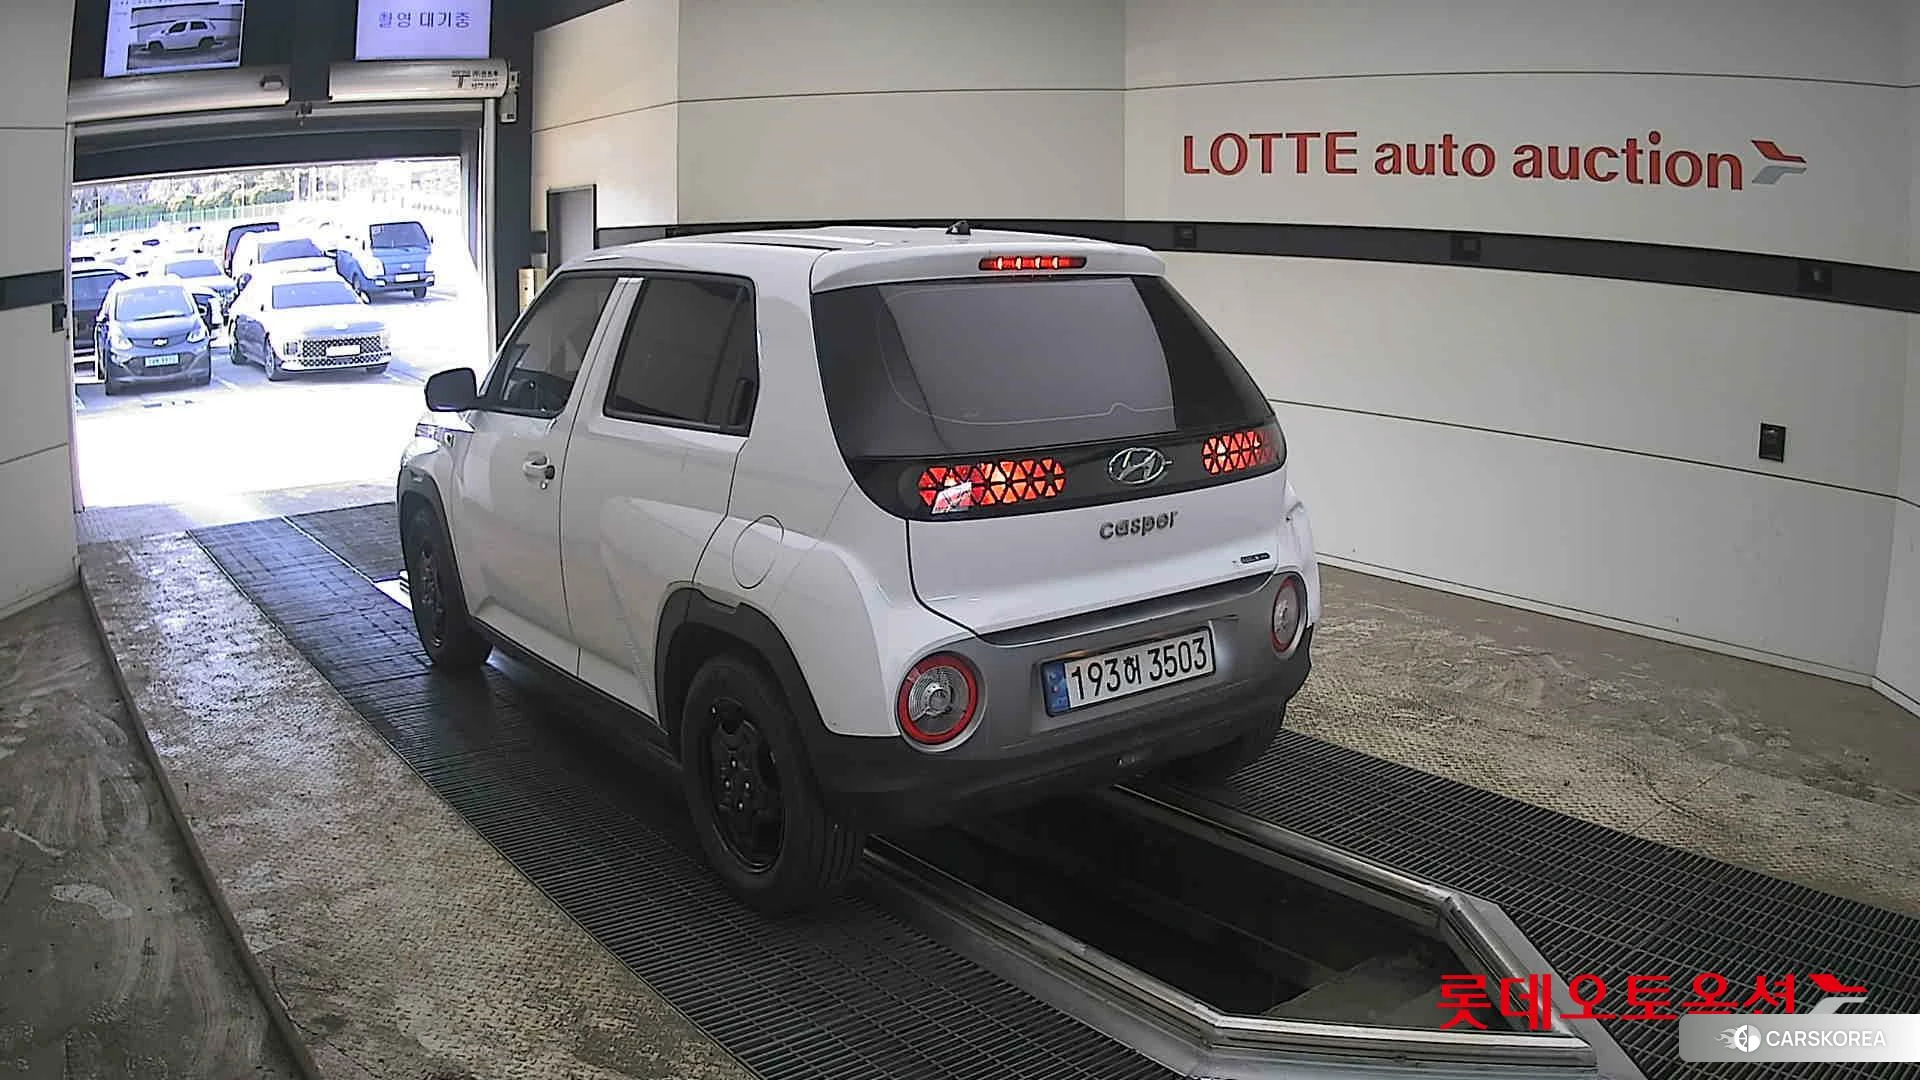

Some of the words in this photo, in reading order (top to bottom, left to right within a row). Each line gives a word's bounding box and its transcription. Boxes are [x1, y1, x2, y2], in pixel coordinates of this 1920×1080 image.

[420, 11, 471, 29] 대기중
[1183, 131, 1358, 176] LOTTE
[1375, 134, 1496, 178] auto
[1512, 130, 1743, 191] auction
[1099, 511, 1178, 540] casper
[1070, 654, 1143, 700] 193허
[1147, 637, 1208, 681] 3503
